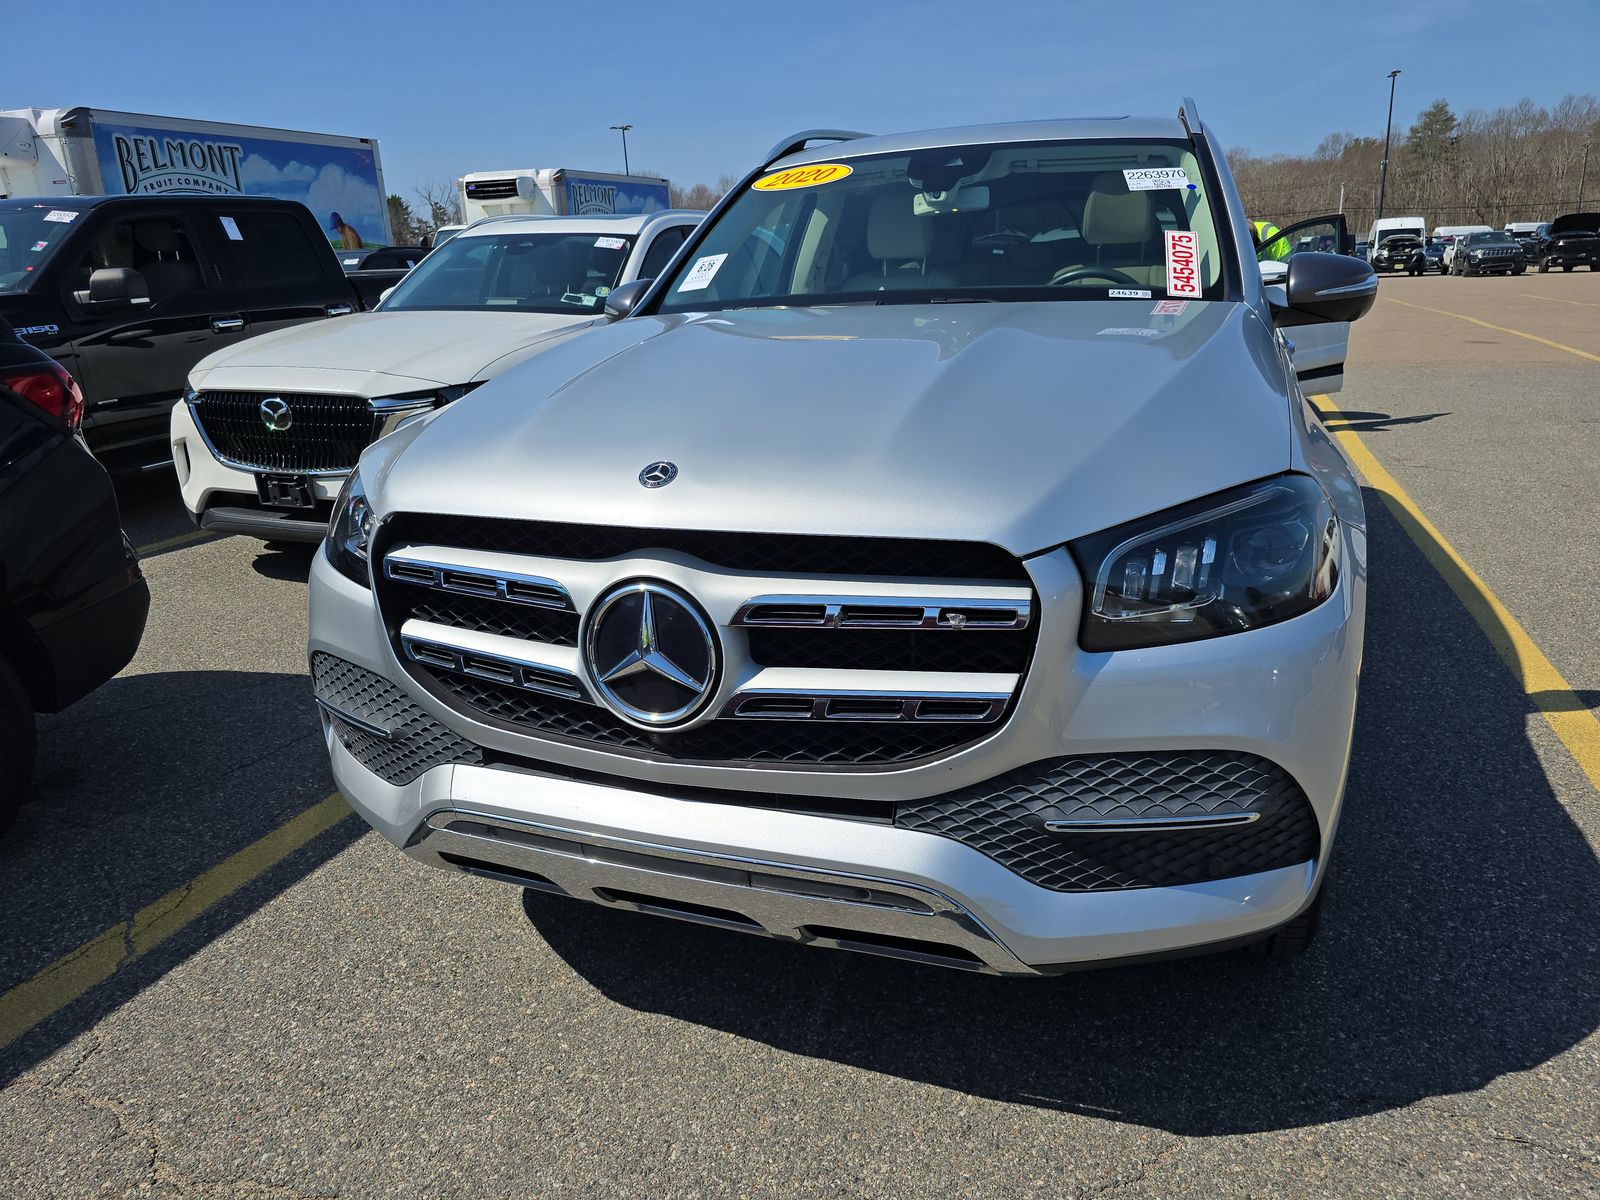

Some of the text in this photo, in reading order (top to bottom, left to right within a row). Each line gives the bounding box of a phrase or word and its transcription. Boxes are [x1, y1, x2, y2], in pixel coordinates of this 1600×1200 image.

[114, 135, 241, 194] BELMONT
[763, 167, 837, 188] 2020
[1127, 169, 1186, 180] 2263970
[144, 177, 230, 194] FRUIT COMPANY
[571, 184, 616, 215] BELMONT
[1171, 235, 1196, 293] 5454075
